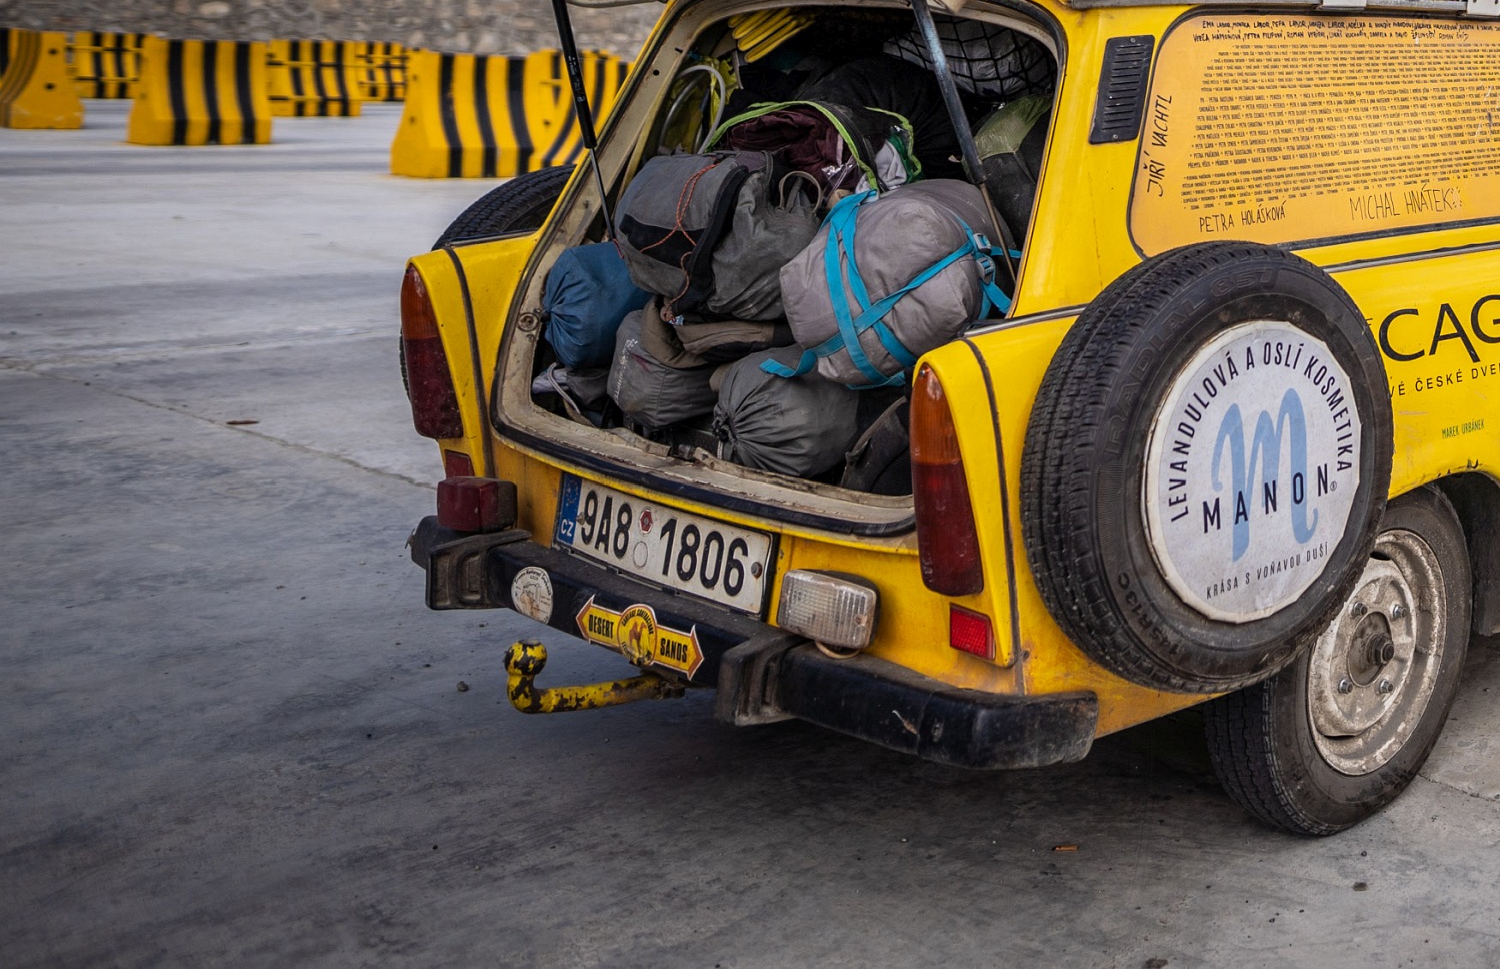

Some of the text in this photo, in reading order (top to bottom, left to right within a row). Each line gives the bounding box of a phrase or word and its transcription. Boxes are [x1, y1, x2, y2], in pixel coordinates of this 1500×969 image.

[1143, 94, 1173, 197] JIŘÍ VACHTL
[1199, 199, 1287, 232] PETRA HOLÁSKOVÁ
[1349, 183, 1452, 221] MICHAL HNÁTEK
[1415, 368, 1464, 392] ČESKÉ
[1169, 342, 1353, 522] LEVANDULOVÁ A OSLÍ KOSMETIKA
[560, 489, 749, 597] CZ 9A8 1806
[1206, 541, 1329, 599] KRÁSA S VOŇAVOU DUŠÍ
[588, 614, 614, 640] DESERT
[659, 637, 688, 663] SANDS
